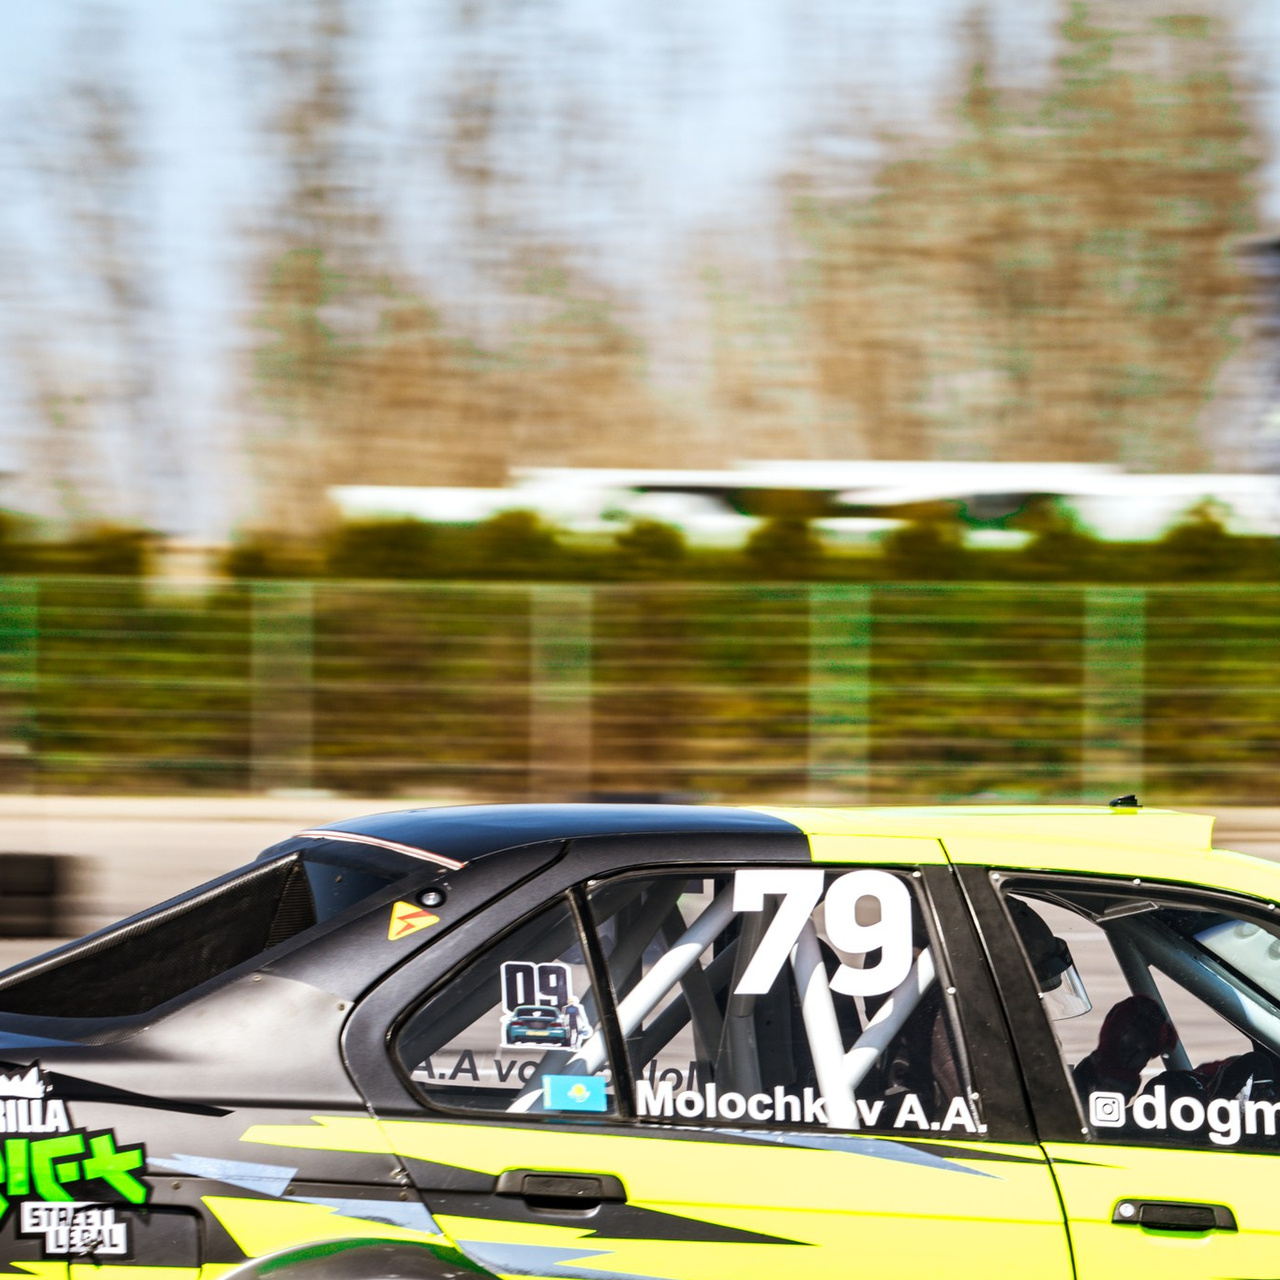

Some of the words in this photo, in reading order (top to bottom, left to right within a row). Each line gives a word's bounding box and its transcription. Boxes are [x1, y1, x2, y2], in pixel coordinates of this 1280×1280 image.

[733, 869, 913, 997] 79
[503, 962, 571, 1013] 09
[893, 1093, 987, 1133] A.A.
[0, 1134, 147, 1210] IFT
